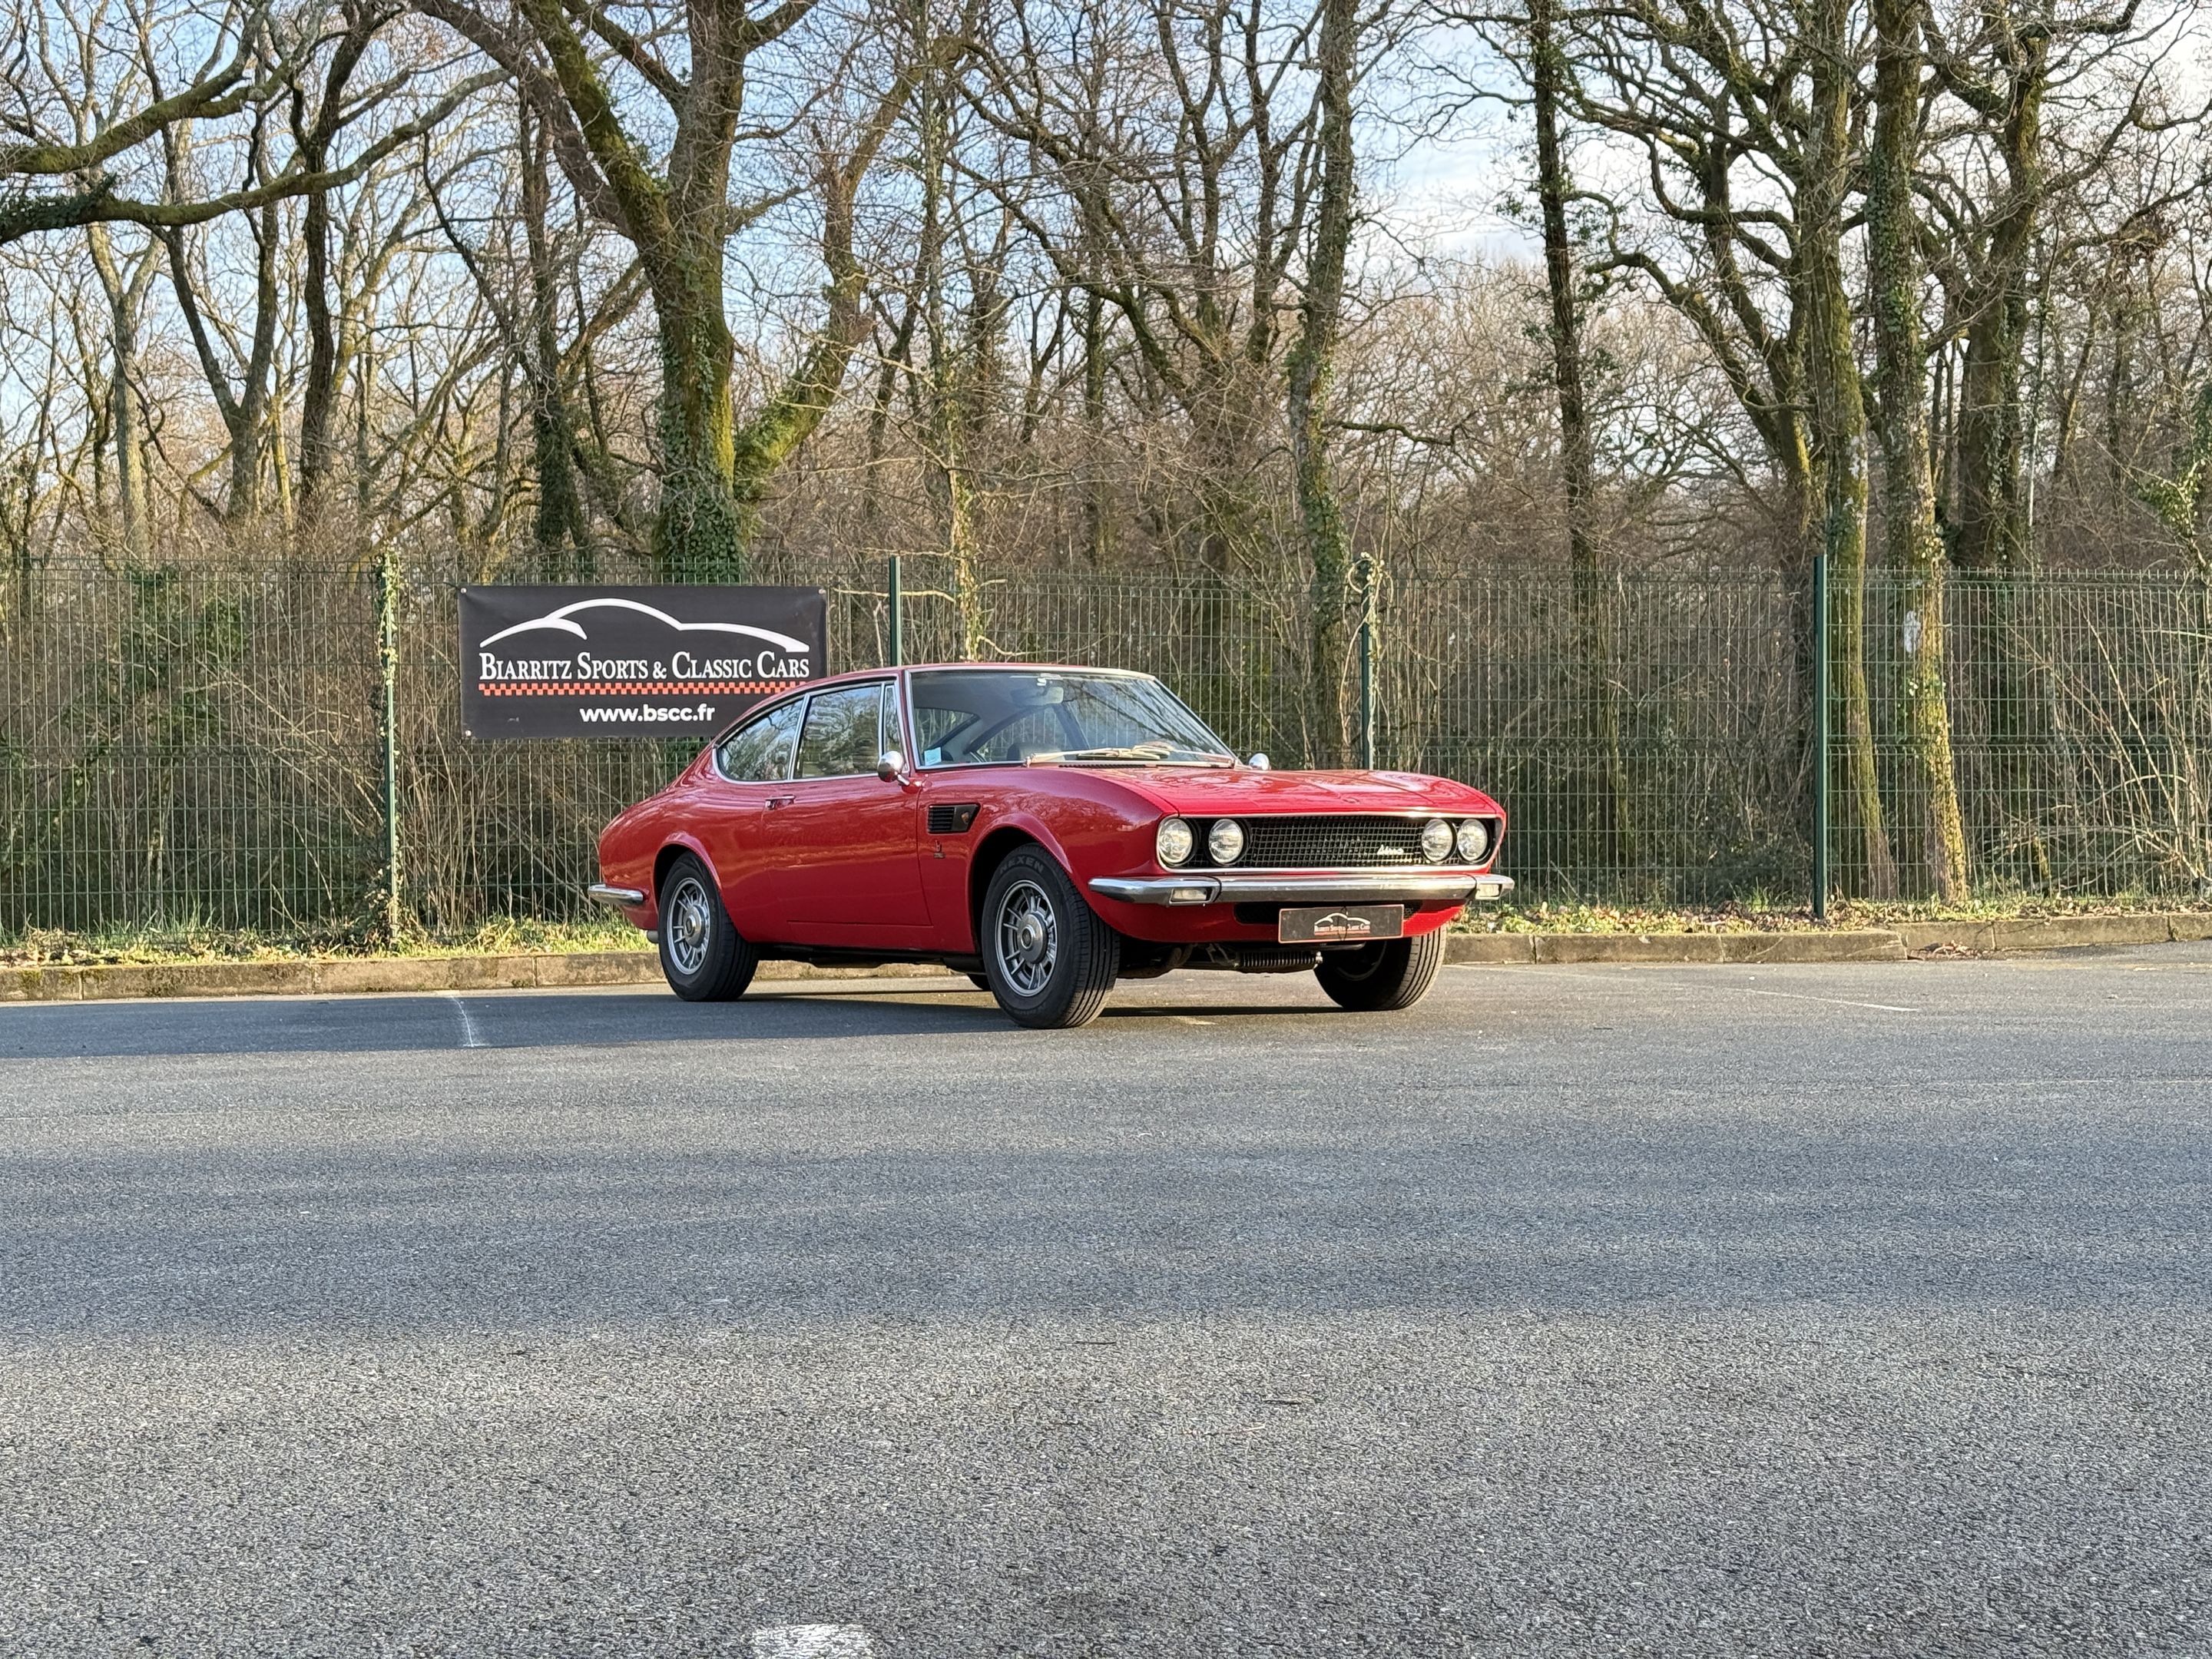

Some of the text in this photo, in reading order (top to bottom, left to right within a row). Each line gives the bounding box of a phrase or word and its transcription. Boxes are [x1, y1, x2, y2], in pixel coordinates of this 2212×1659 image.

[652, 661, 667, 679] &
[580, 703, 715, 722] www.bscc.fr
[999, 856, 1044, 874] NEXEN
